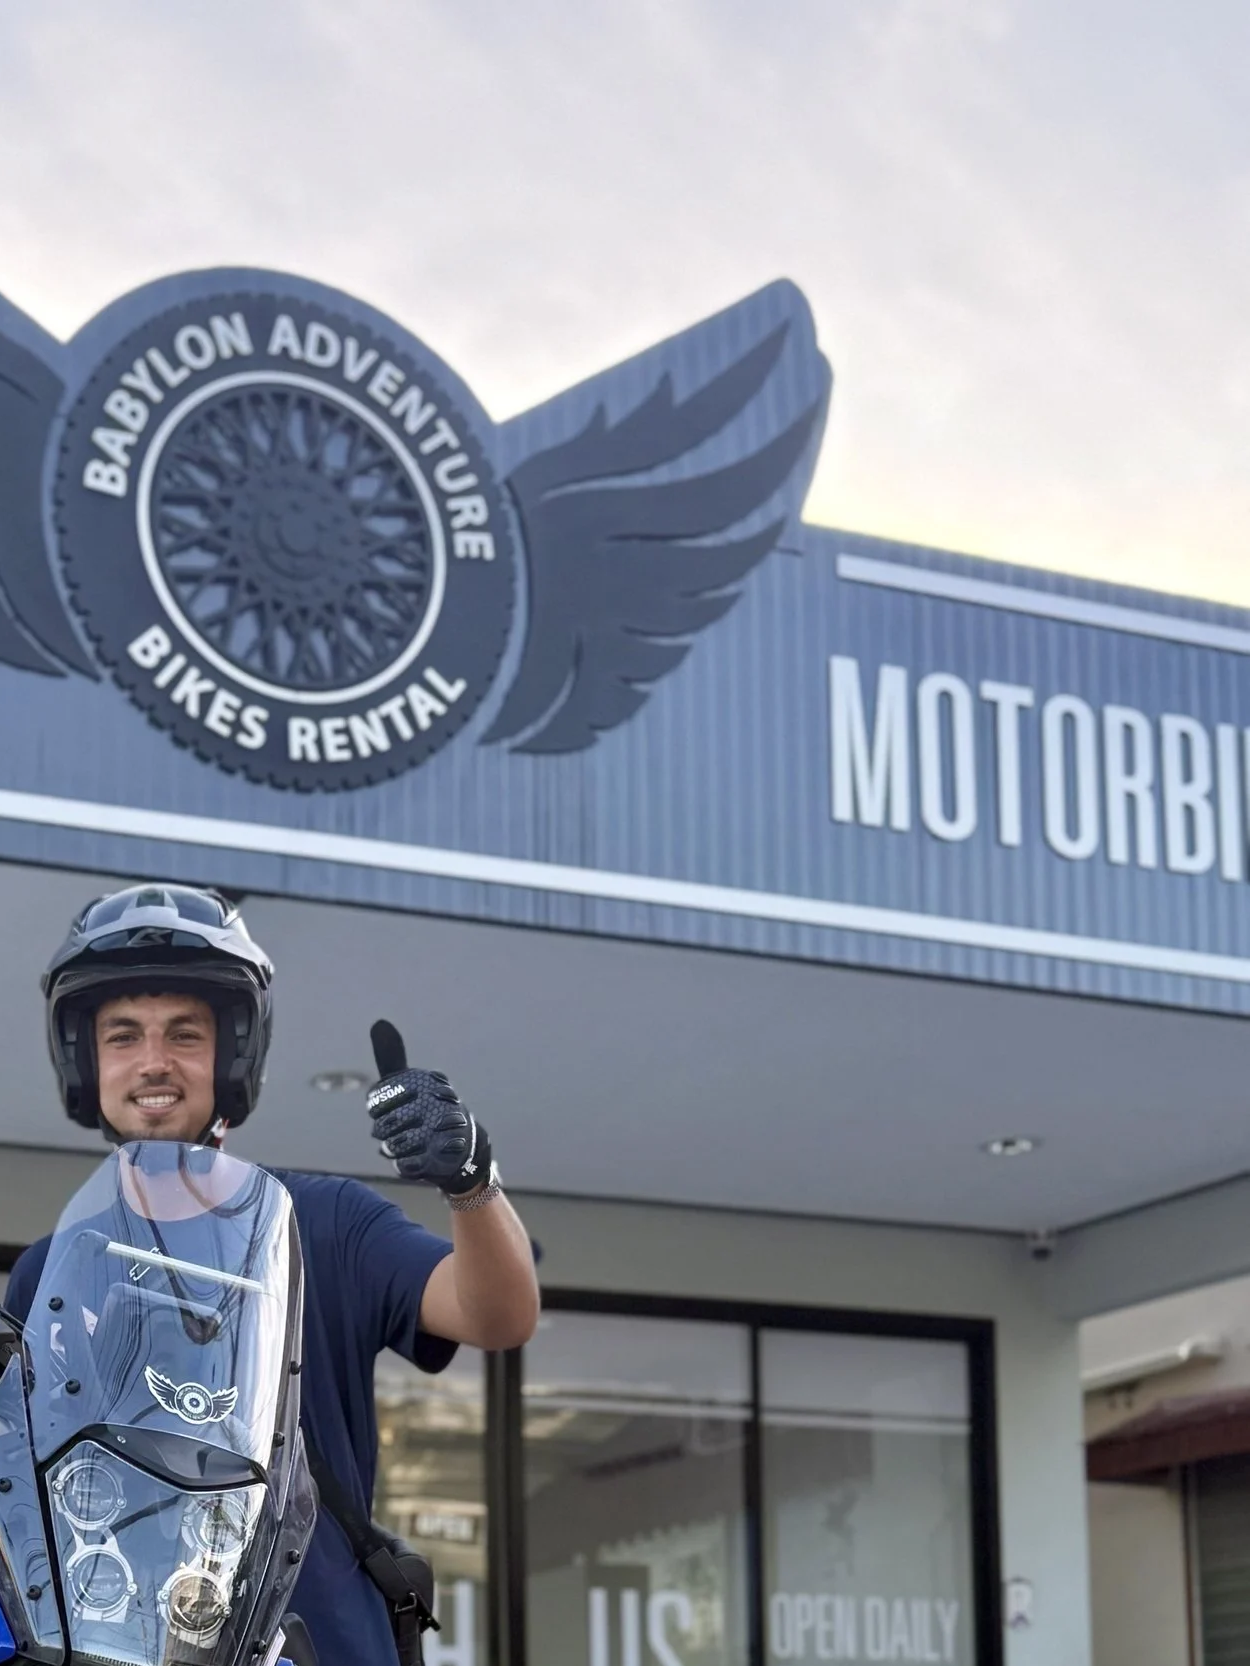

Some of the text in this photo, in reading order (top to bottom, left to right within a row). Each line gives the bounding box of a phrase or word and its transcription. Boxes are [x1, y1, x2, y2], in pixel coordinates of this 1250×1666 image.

[83, 312, 495, 561] BABYLON ADVENTURE
[127, 624, 468, 762] BIKES RENTAL
[829, 654, 1250, 884] MOTORBI
[769, 1592, 960, 1663] OPEN DAILY
